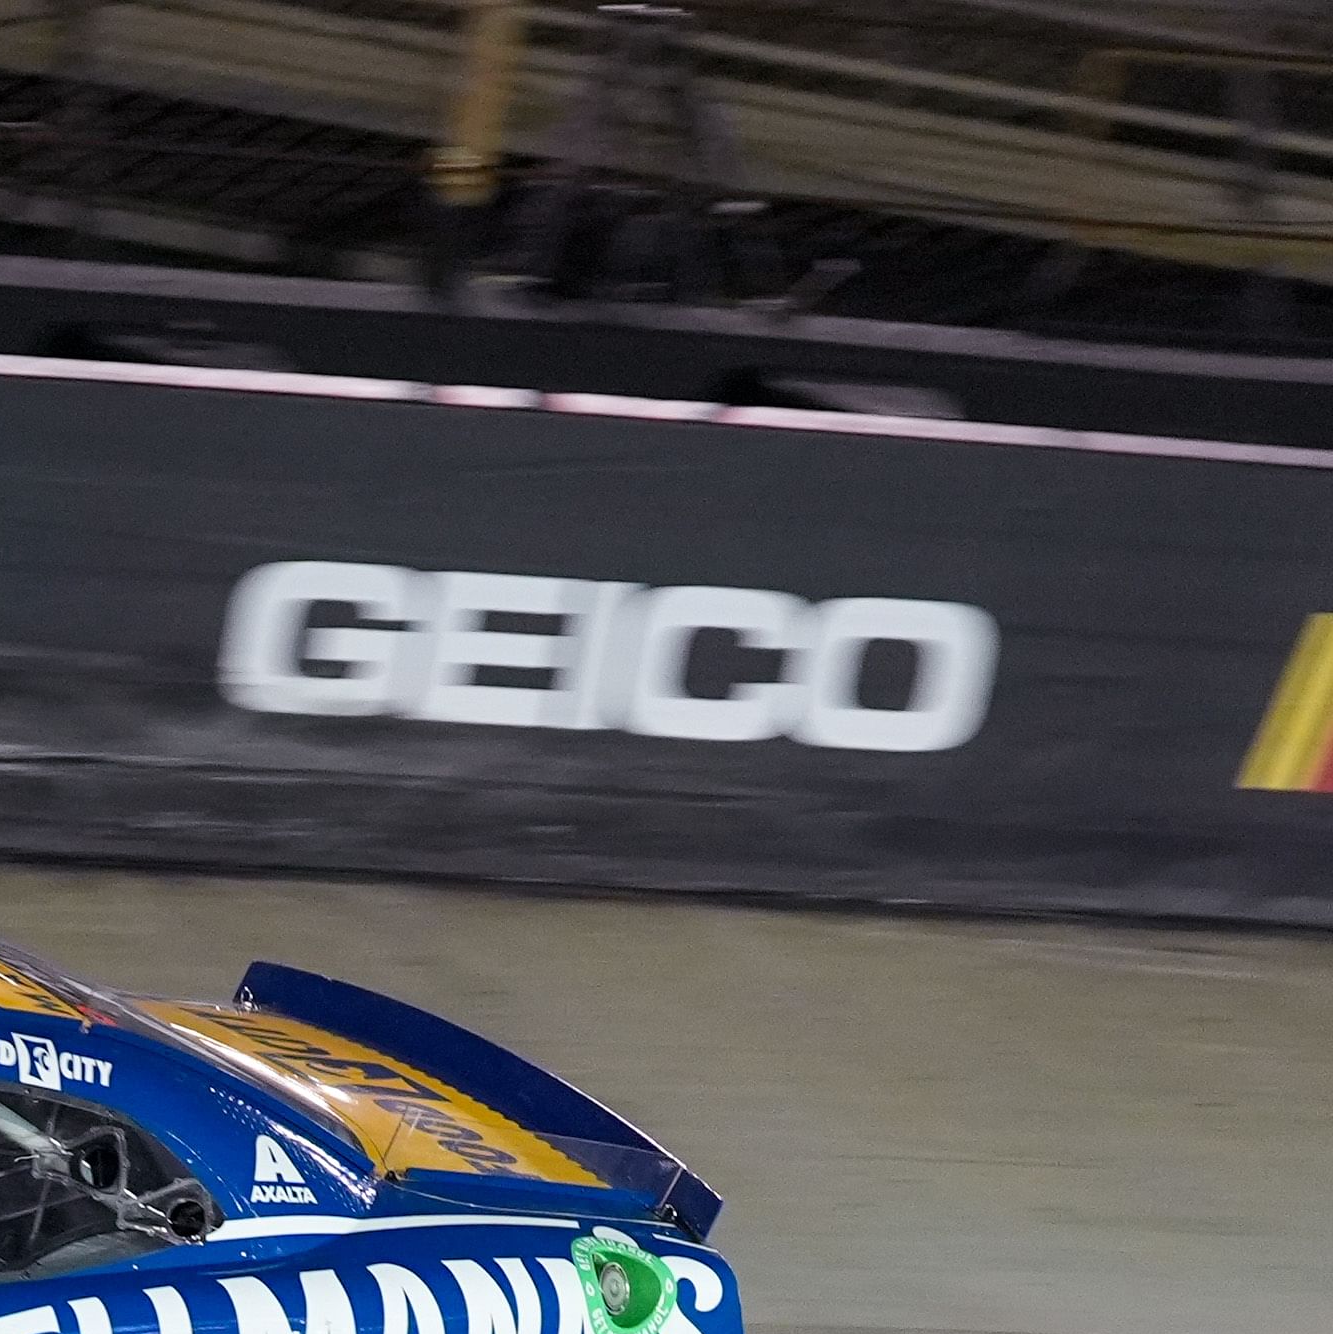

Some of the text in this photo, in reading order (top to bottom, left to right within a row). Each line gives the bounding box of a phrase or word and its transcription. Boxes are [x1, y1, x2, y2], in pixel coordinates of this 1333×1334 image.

[218, 560, 1000, 752] GEICO
[60, 1052, 113, 1088] CITY
[250, 1184, 318, 1205] AXALTA
